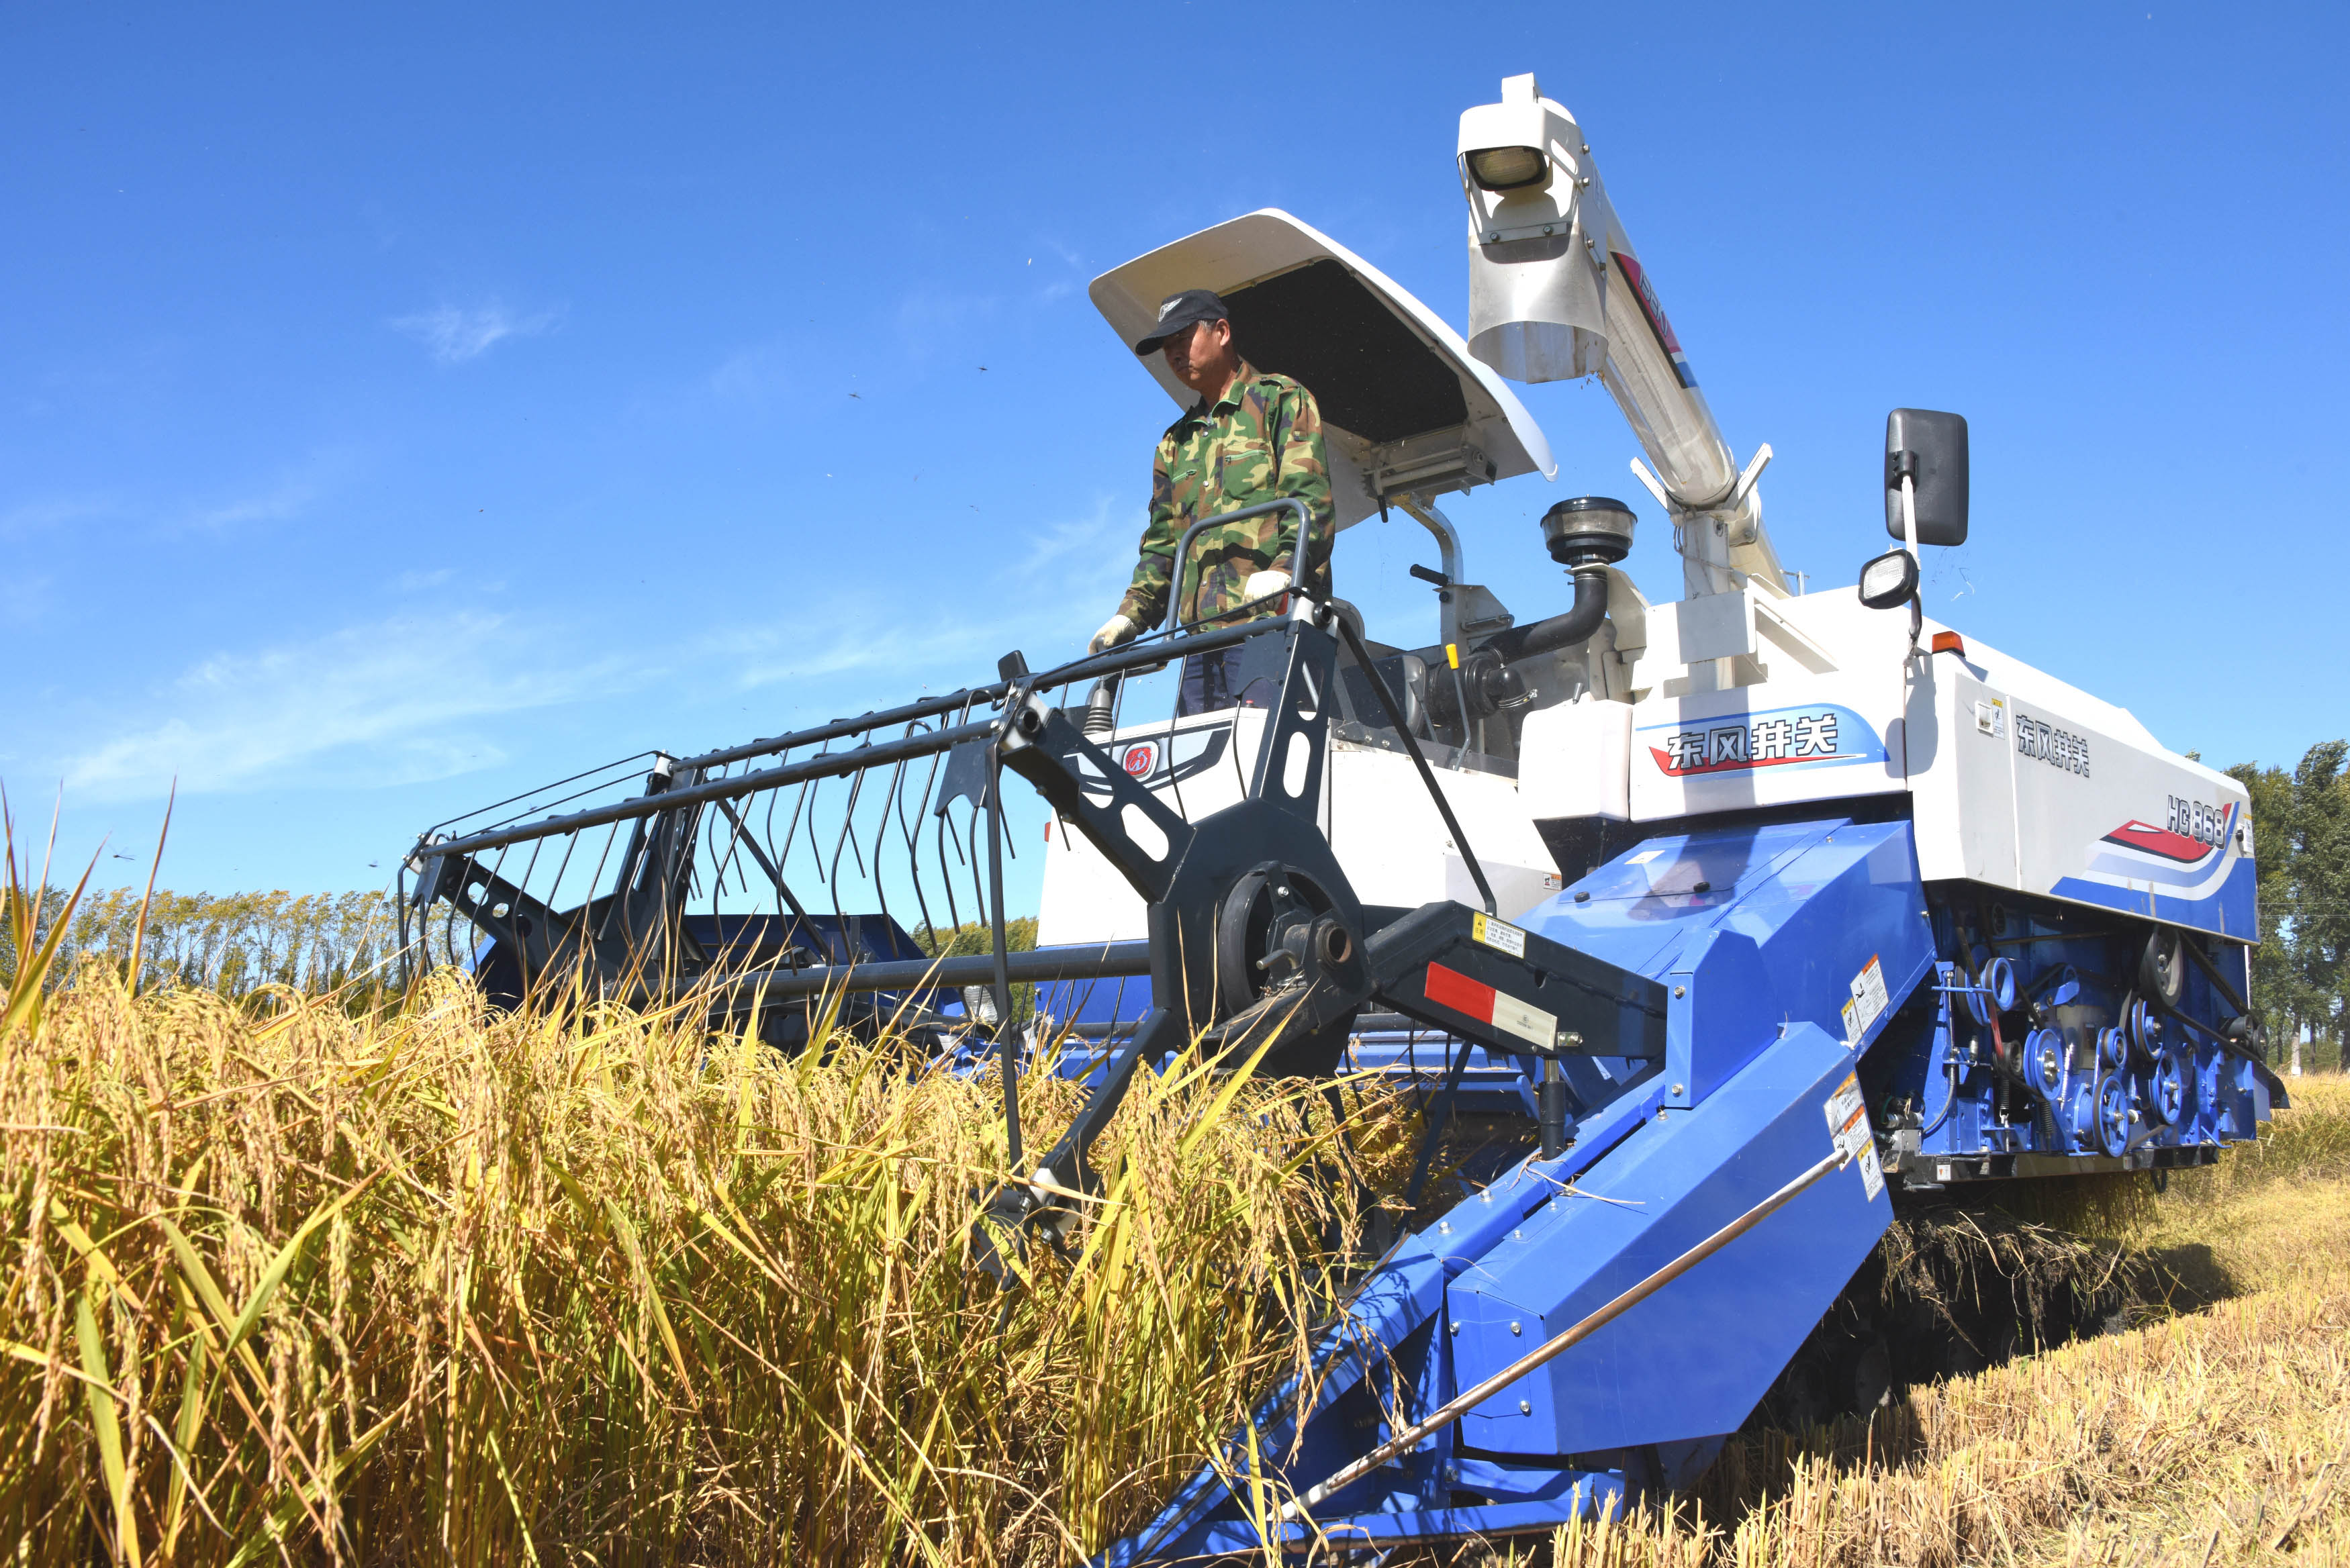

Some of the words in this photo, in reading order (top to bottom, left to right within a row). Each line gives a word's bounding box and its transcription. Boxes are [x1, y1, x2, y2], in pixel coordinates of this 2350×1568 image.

[1668, 714, 1838, 770] 东风井关
[2016, 714, 2089, 778] 东风井关
